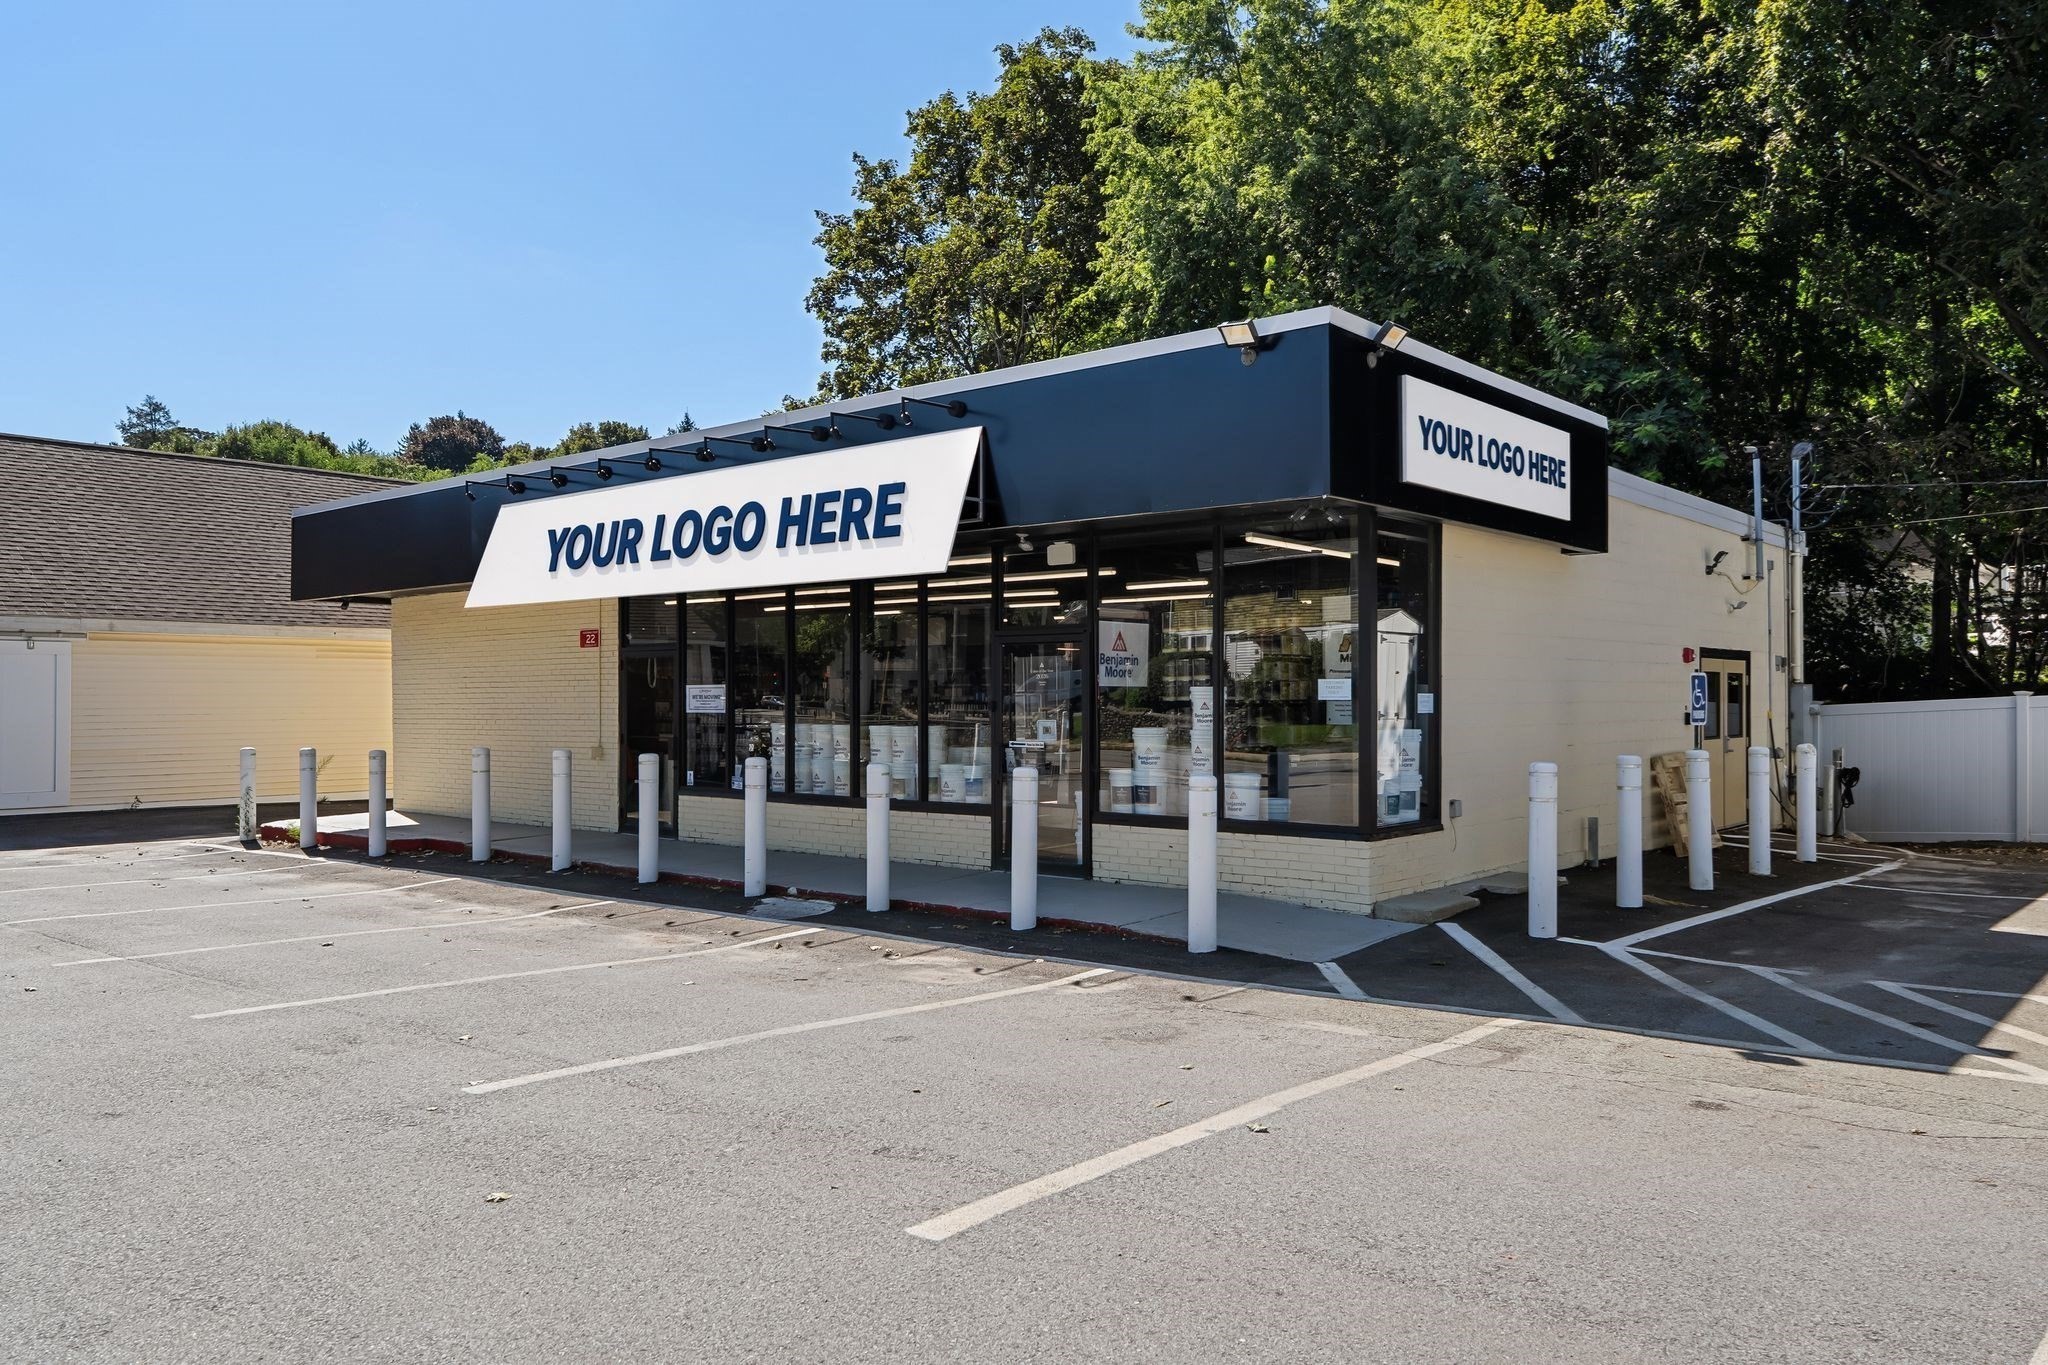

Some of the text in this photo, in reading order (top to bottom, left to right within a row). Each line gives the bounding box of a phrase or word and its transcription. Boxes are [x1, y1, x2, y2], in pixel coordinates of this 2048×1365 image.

[1418, 415, 1566, 489] YOUR LOGO HERE
[547, 482, 906, 572] YOUR LOGO HERE
[585, 634, 596, 644] 22
[1099, 652, 1139, 668] Benjamin
[1104, 666, 1132, 678] Moore
